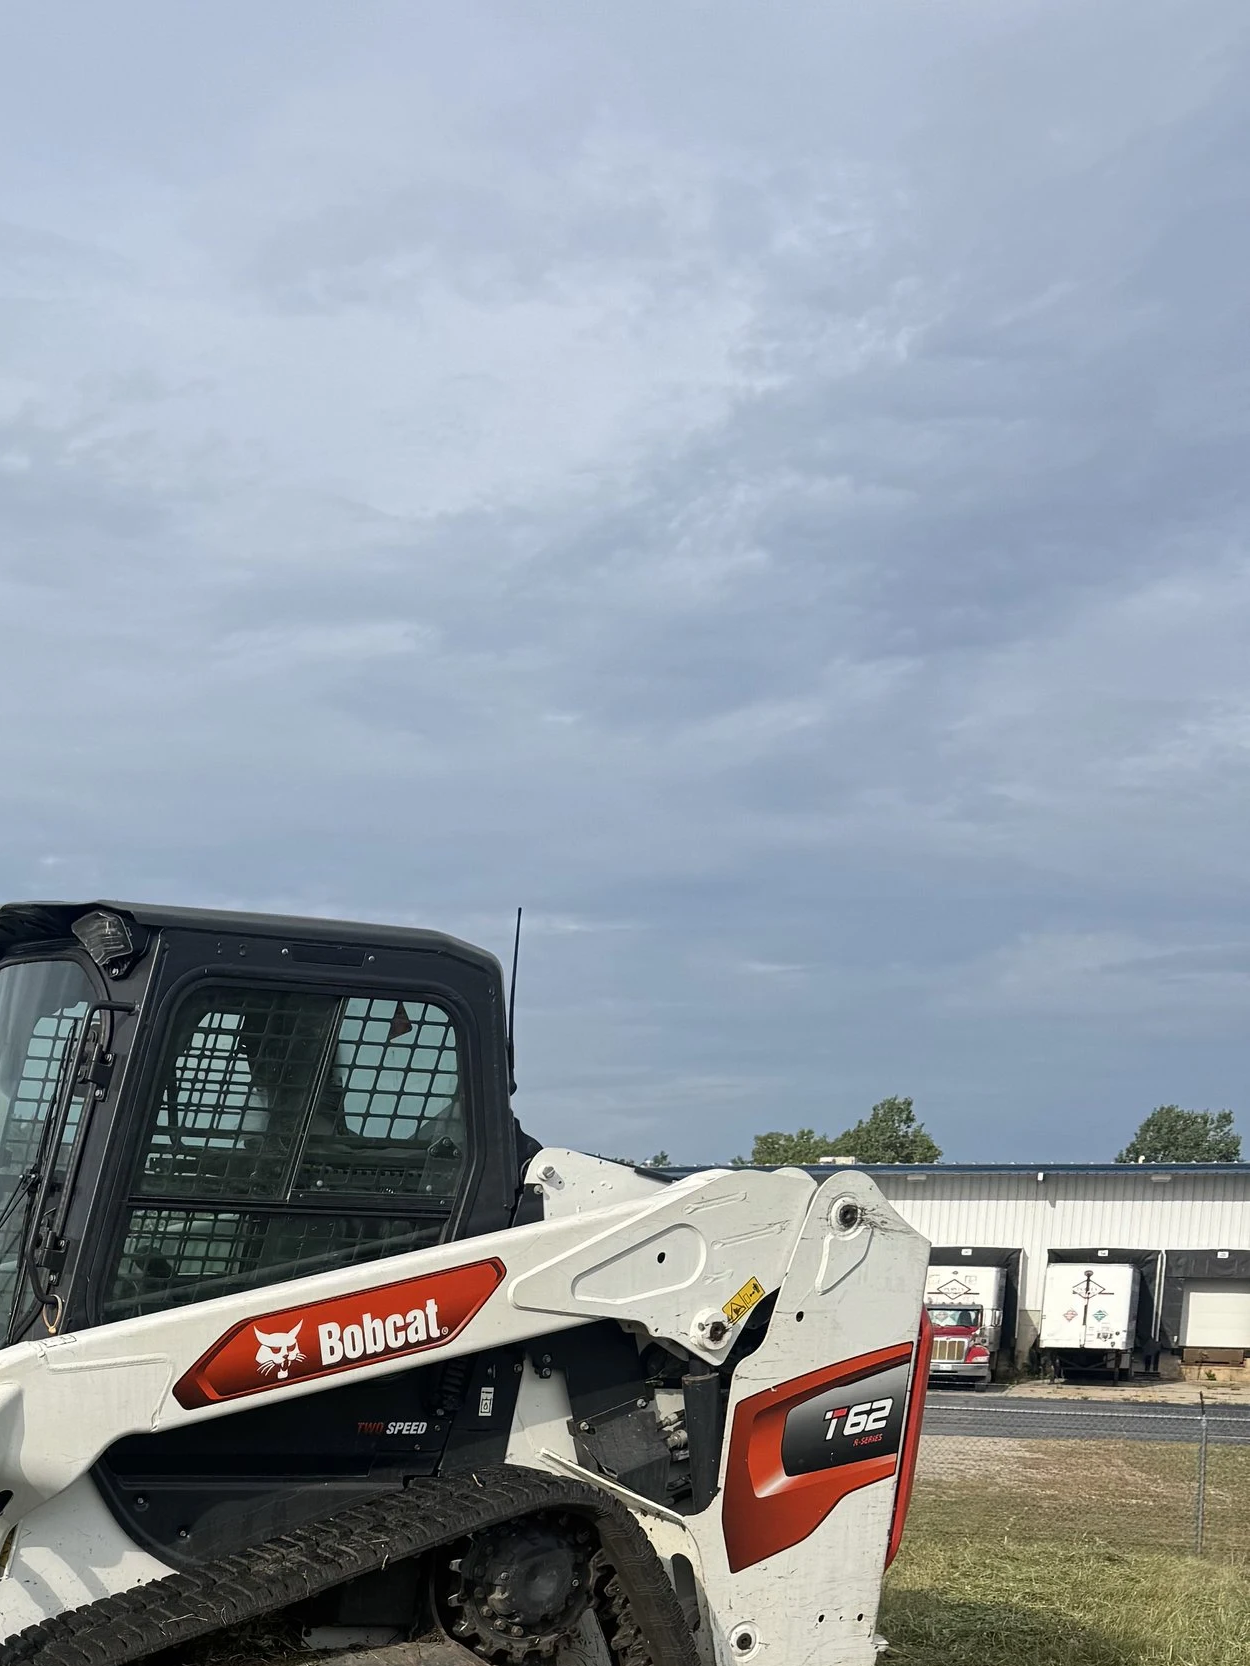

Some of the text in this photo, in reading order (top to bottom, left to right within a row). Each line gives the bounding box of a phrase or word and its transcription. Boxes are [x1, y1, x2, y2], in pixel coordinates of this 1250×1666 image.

[318, 1299, 440, 1366] Bobcat
[357, 1422, 428, 1435] TWO SPEED
[824, 1398, 893, 1441] T62
